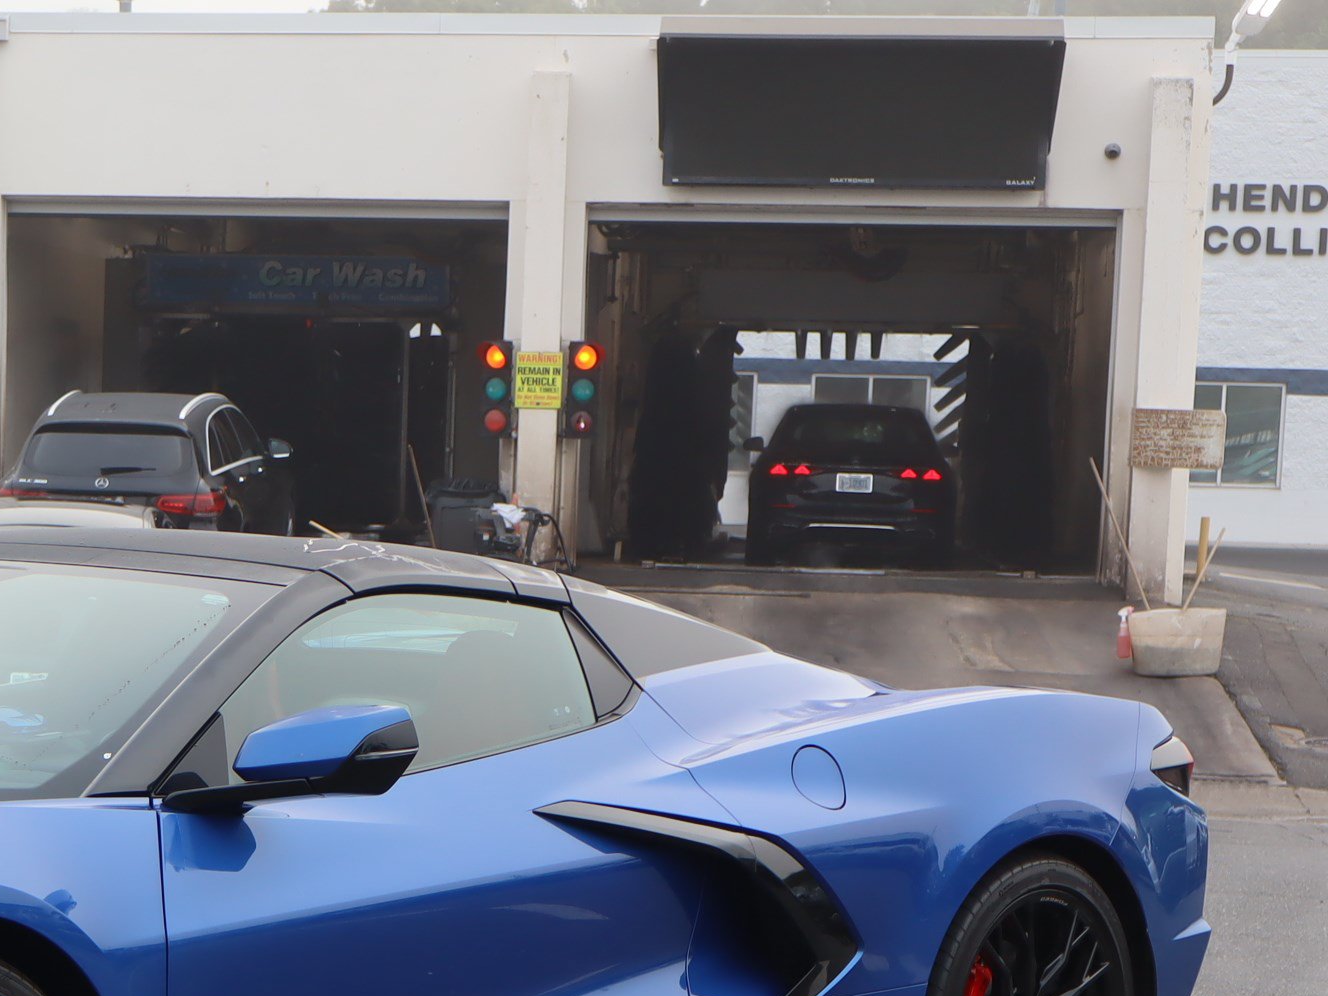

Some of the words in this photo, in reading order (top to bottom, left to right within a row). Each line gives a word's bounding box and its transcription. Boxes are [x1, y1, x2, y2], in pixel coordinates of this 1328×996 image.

[1212, 183, 1328, 212] HEND
[1204, 225, 1328, 256] COLLI
[258, 260, 321, 287] Car
[332, 259, 427, 288] Wash
[518, 354, 561, 363] WARNING!
[517, 367, 551, 376] REMAIN
[552, 367, 561, 376] IN
[520, 376, 558, 386] VEHICLE
